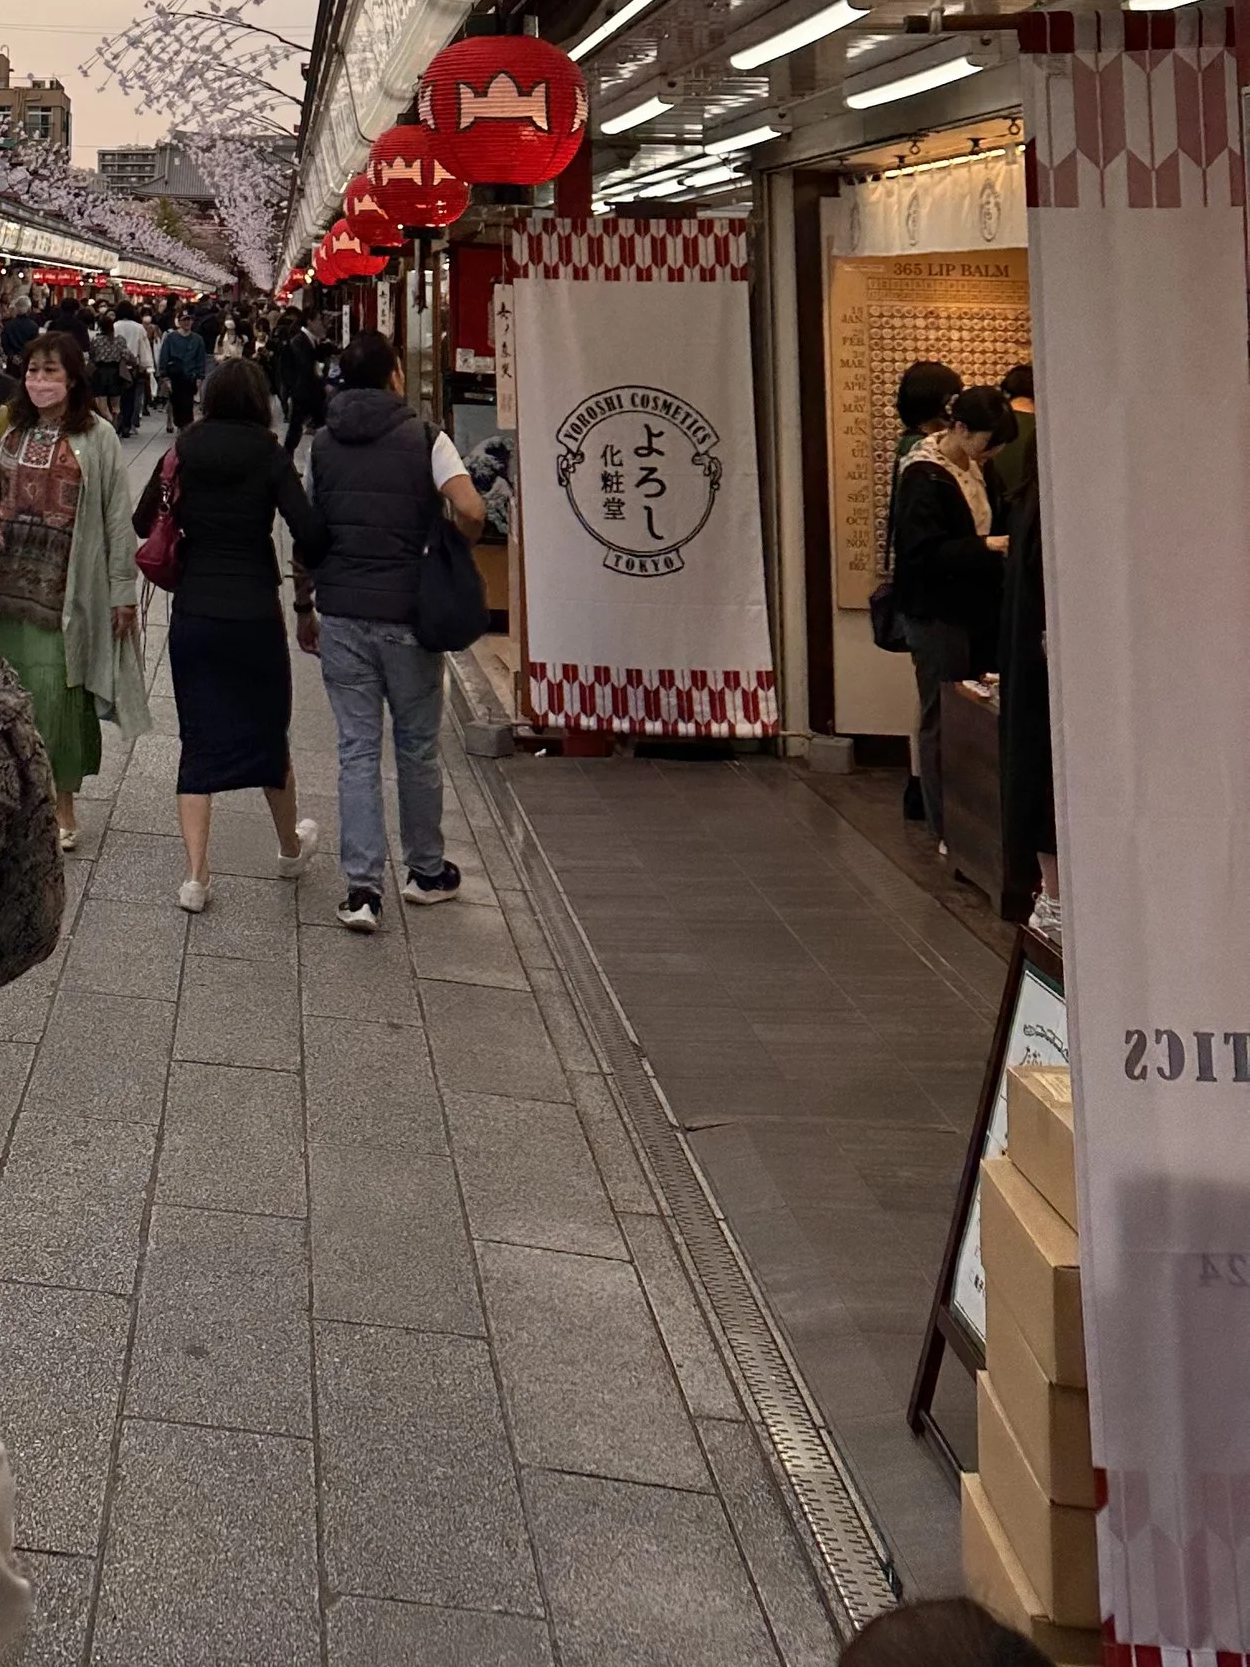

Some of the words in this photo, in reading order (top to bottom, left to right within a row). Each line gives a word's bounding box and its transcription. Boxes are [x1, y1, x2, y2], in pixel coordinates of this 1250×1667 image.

[893, 262, 922, 275] 365
[928, 263, 956, 277] LIP
[961, 264, 1010, 278] BALM
[564, 394, 624, 443] YOROSHI
[631, 393, 711, 444] COSMETICS
[601, 444, 626, 520] 化粧堂
[634, 424, 667, 540] よろし
[614, 554, 675, 574] TOKYO
